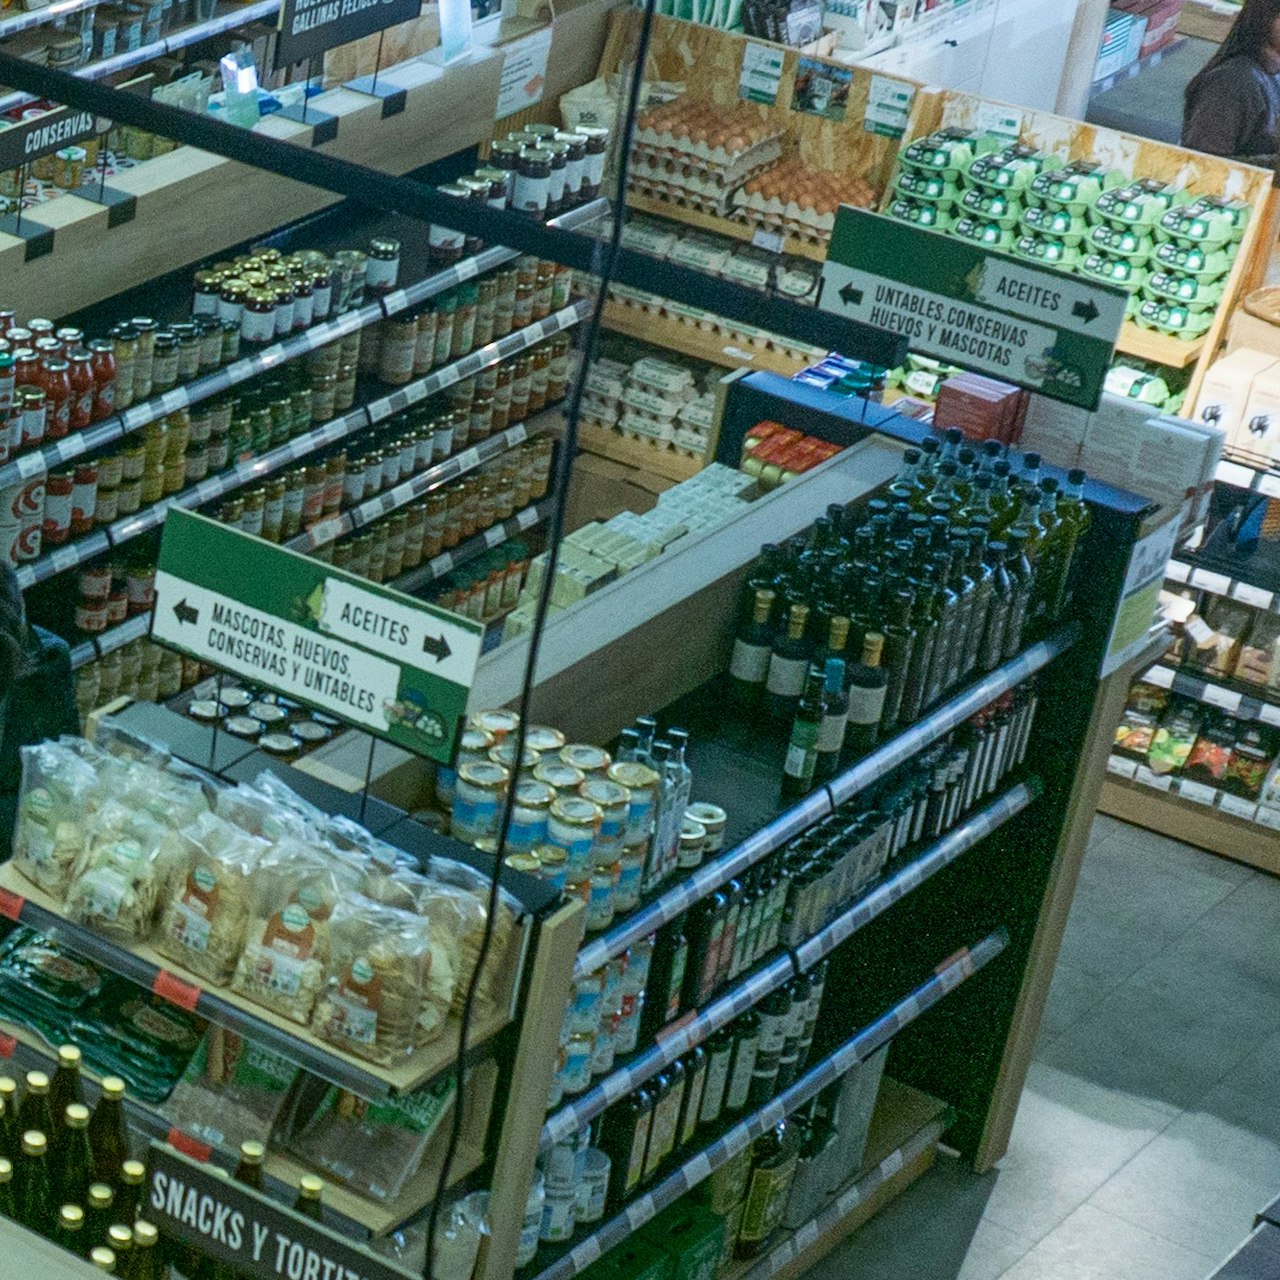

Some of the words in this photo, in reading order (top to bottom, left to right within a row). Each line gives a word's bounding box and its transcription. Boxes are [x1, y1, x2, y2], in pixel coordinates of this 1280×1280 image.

[291, 0, 340, 36] GALLINAS
[24, 111, 93, 154] CONSERVAS
[996, 276, 1062, 311] ACEITES
[870, 307, 923, 338] HUEVOS
[927, 322, 937, 341] Y
[939, 328, 1012, 366] MASCOTAS
[211, 602, 287, 652] MASCOTAS,
[294, 634, 351, 678] HUEVOS,
[341, 602, 410, 646] ACEITES
[207, 628, 287, 677] CONSERVAS
[292, 660, 301, 682] Y
[304, 666, 375, 714] UNTABLES
[150, 1171, 244, 1251] SNACKS
[252, 1219, 269, 1262] Y
